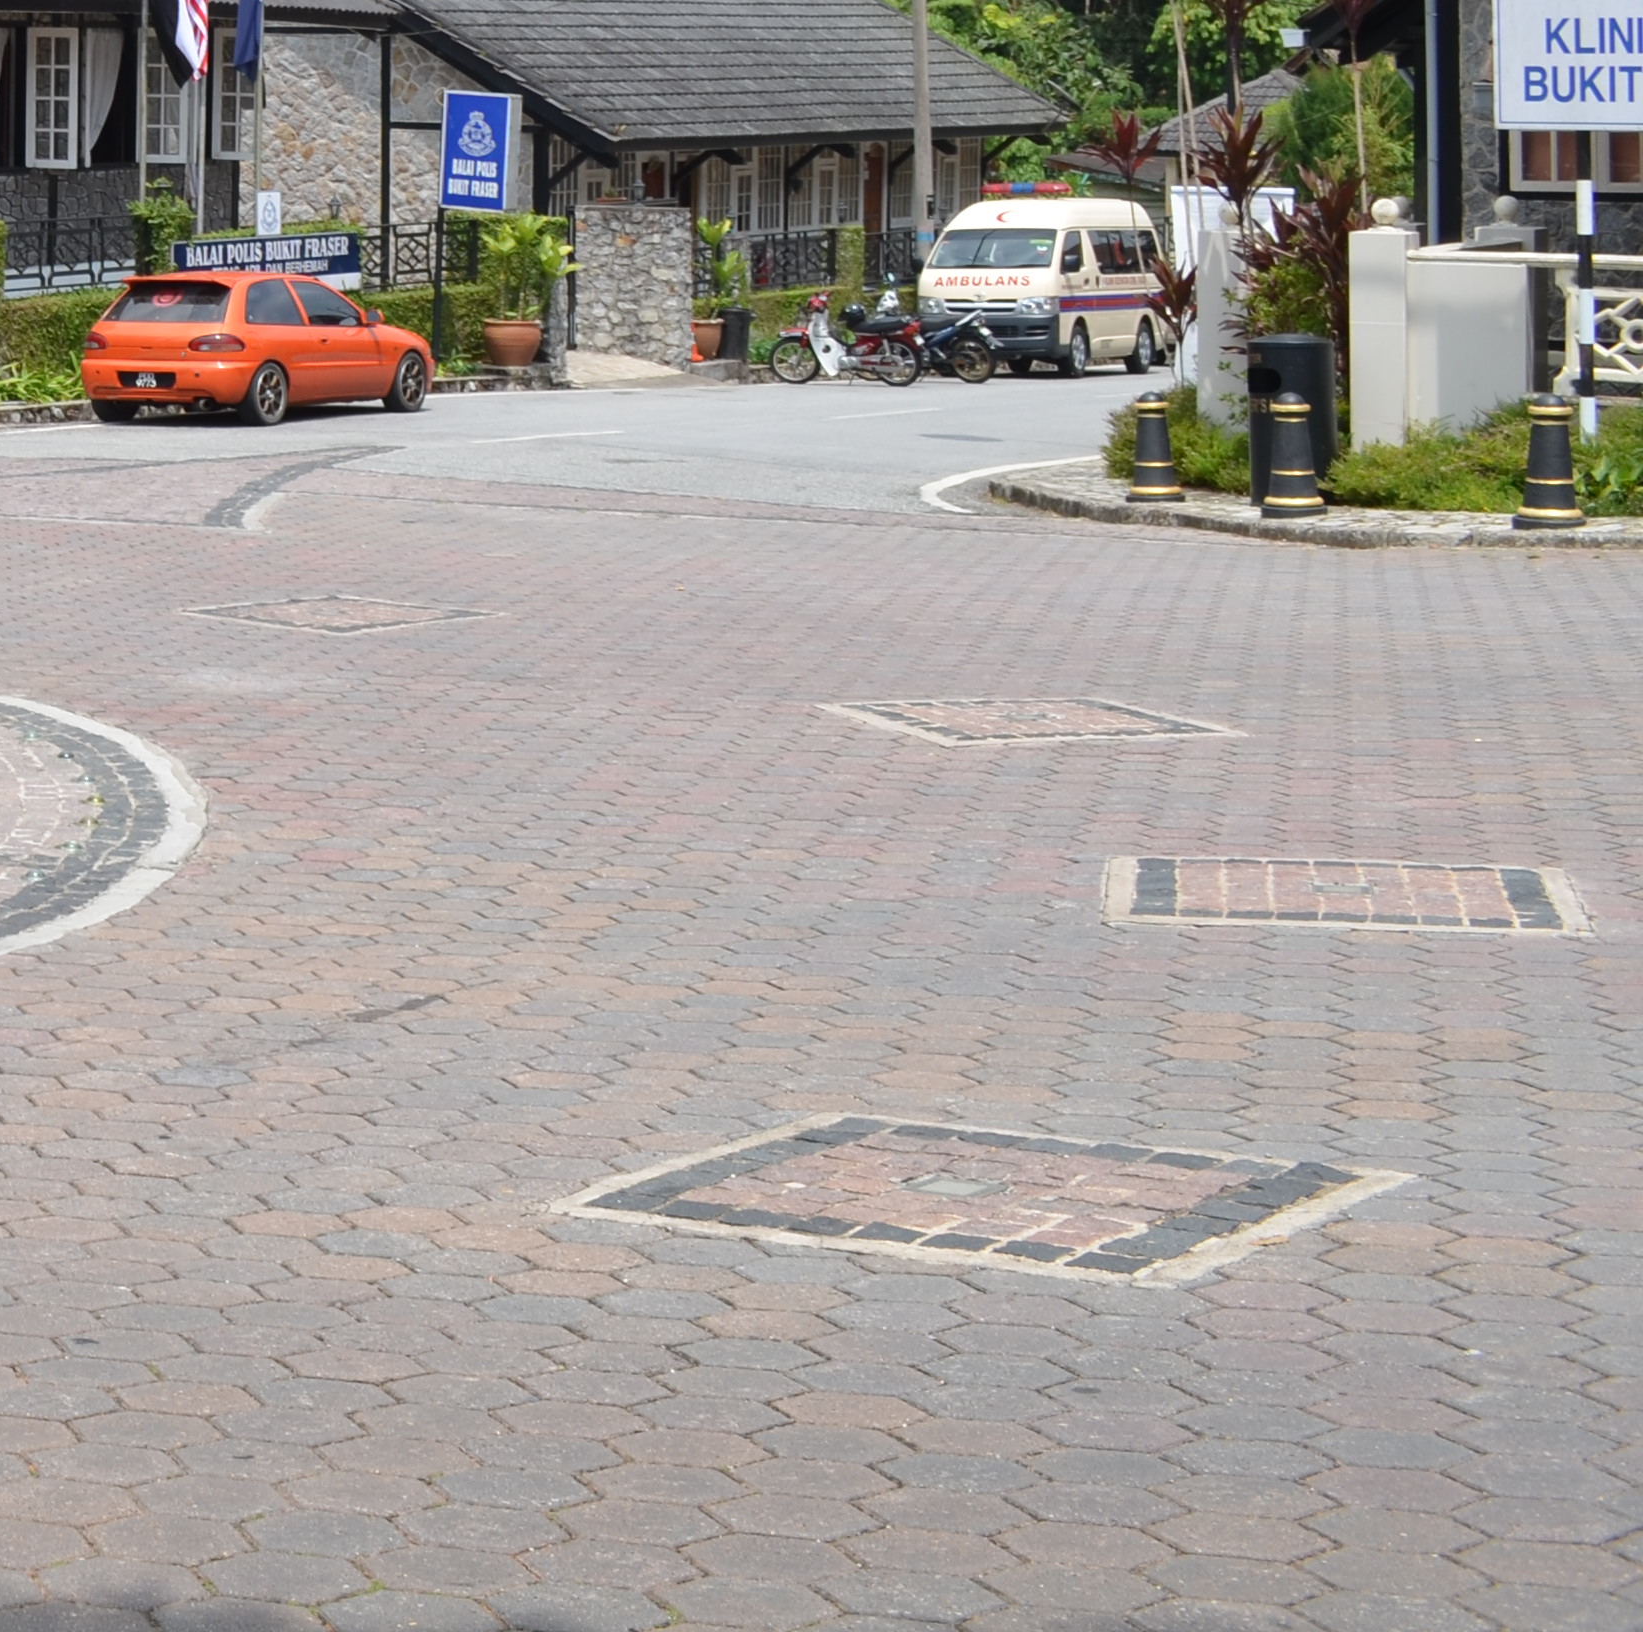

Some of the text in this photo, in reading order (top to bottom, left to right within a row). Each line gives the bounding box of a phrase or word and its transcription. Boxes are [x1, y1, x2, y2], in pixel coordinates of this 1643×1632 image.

[1524, 66, 1643, 103] BUKIT
[452, 158, 498, 178] BALAI POLIS
[448, 178, 499, 199] BUKIT FRASER
[186, 236, 350, 267] BALAI POLIS BUKIT FRASER
[285, 259, 328, 274] BERHEMAH
[934, 275, 1032, 287] AMBULANS
